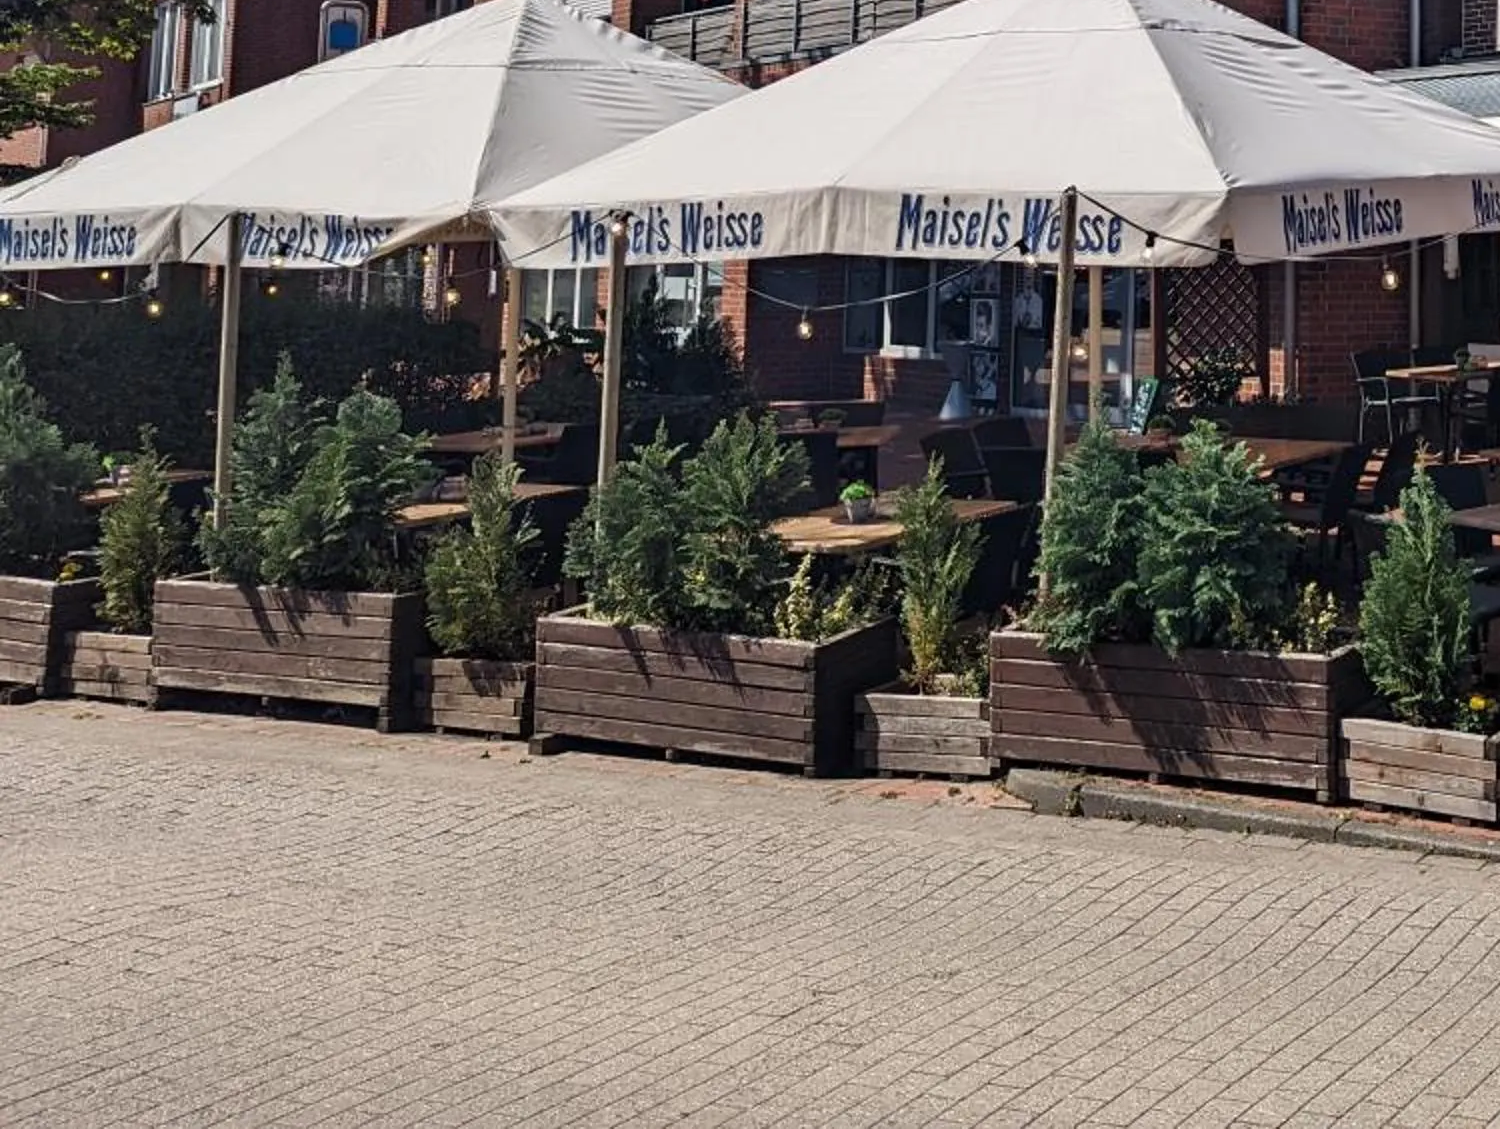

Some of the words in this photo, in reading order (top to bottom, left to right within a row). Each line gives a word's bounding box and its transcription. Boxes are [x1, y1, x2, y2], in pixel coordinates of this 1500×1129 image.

[74, 214, 136, 263] Weisse
[571, 206, 670, 262] Mael's
[681, 200, 763, 257] Weisse
[896, 193, 1010, 251] Maisel's
[1023, 198, 1123, 255] Wesse
[1282, 191, 1340, 254] Maisel's
[1343, 187, 1402, 243] Weisse
